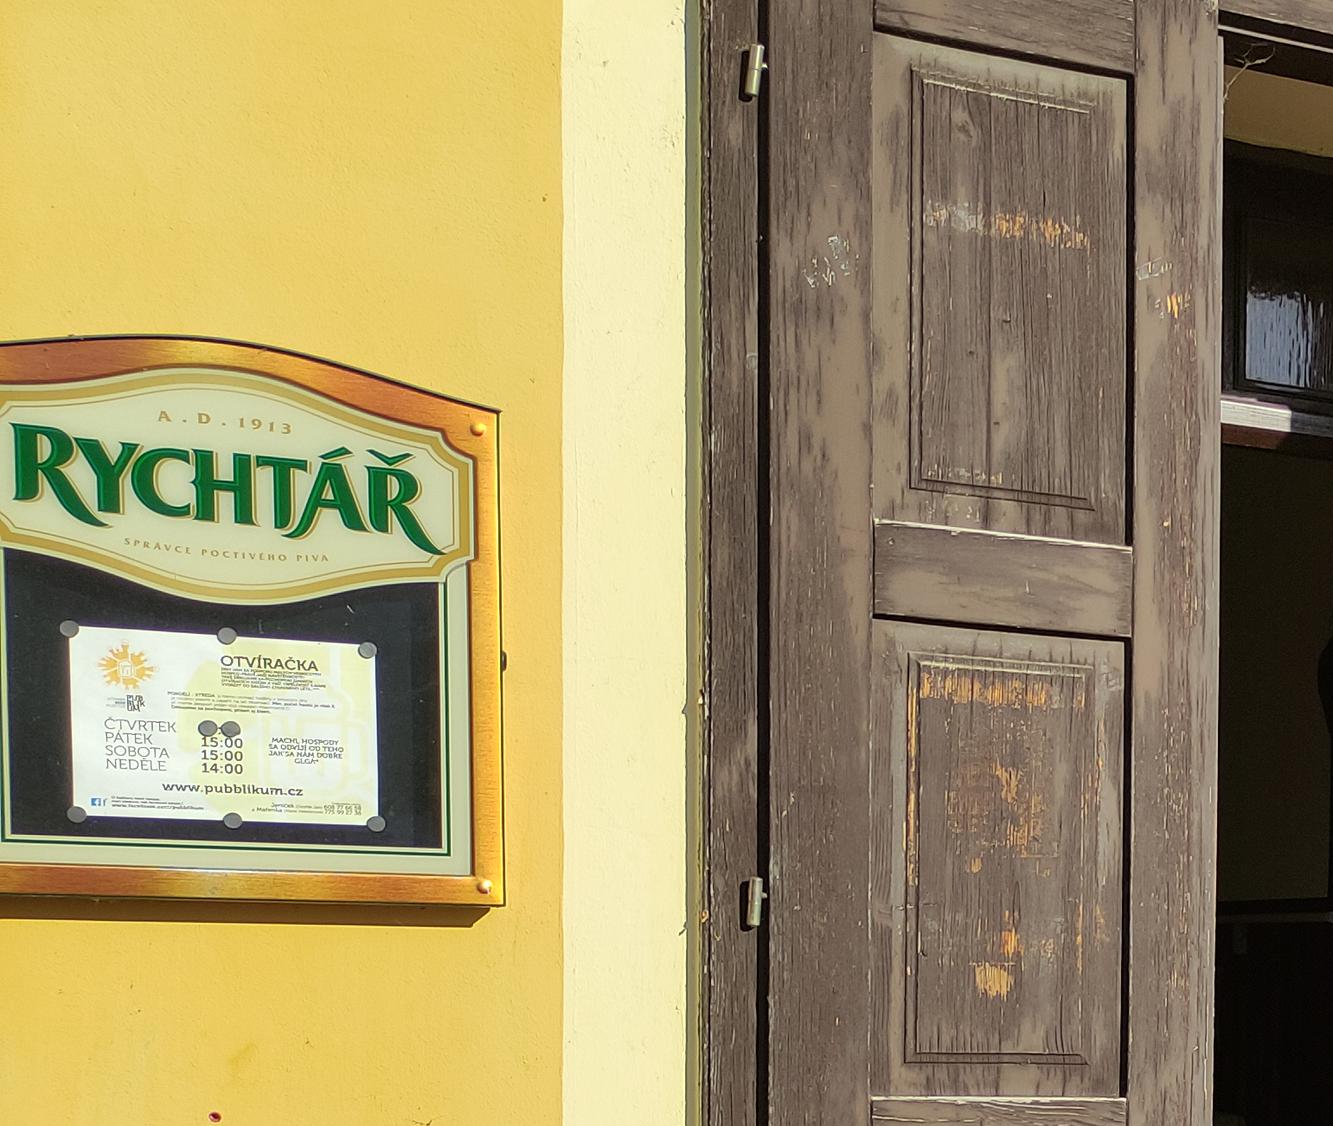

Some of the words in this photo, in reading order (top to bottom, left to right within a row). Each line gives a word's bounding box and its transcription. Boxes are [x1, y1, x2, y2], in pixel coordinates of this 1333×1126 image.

[9, 422, 447, 555] RYCHTÁŘ
[123, 537, 192, 555] SPRÁVCE
[201, 548, 288, 562] POCTIVÉHO
[296, 554, 329, 563] PIVA
[220, 654, 319, 672] OTVÍRAČKA
[104, 716, 177, 733] ČTVRTEK
[105, 730, 153, 745] PÁTEK
[201, 736, 243, 749] 15:00
[105, 745, 170, 759] SOBOTA
[201, 749, 243, 762] 15:00
[105, 757, 168, 772] NEDĚLE
[201, 762, 244, 775] 14:00
[162, 782, 304, 797] www.pubblikum.cz
